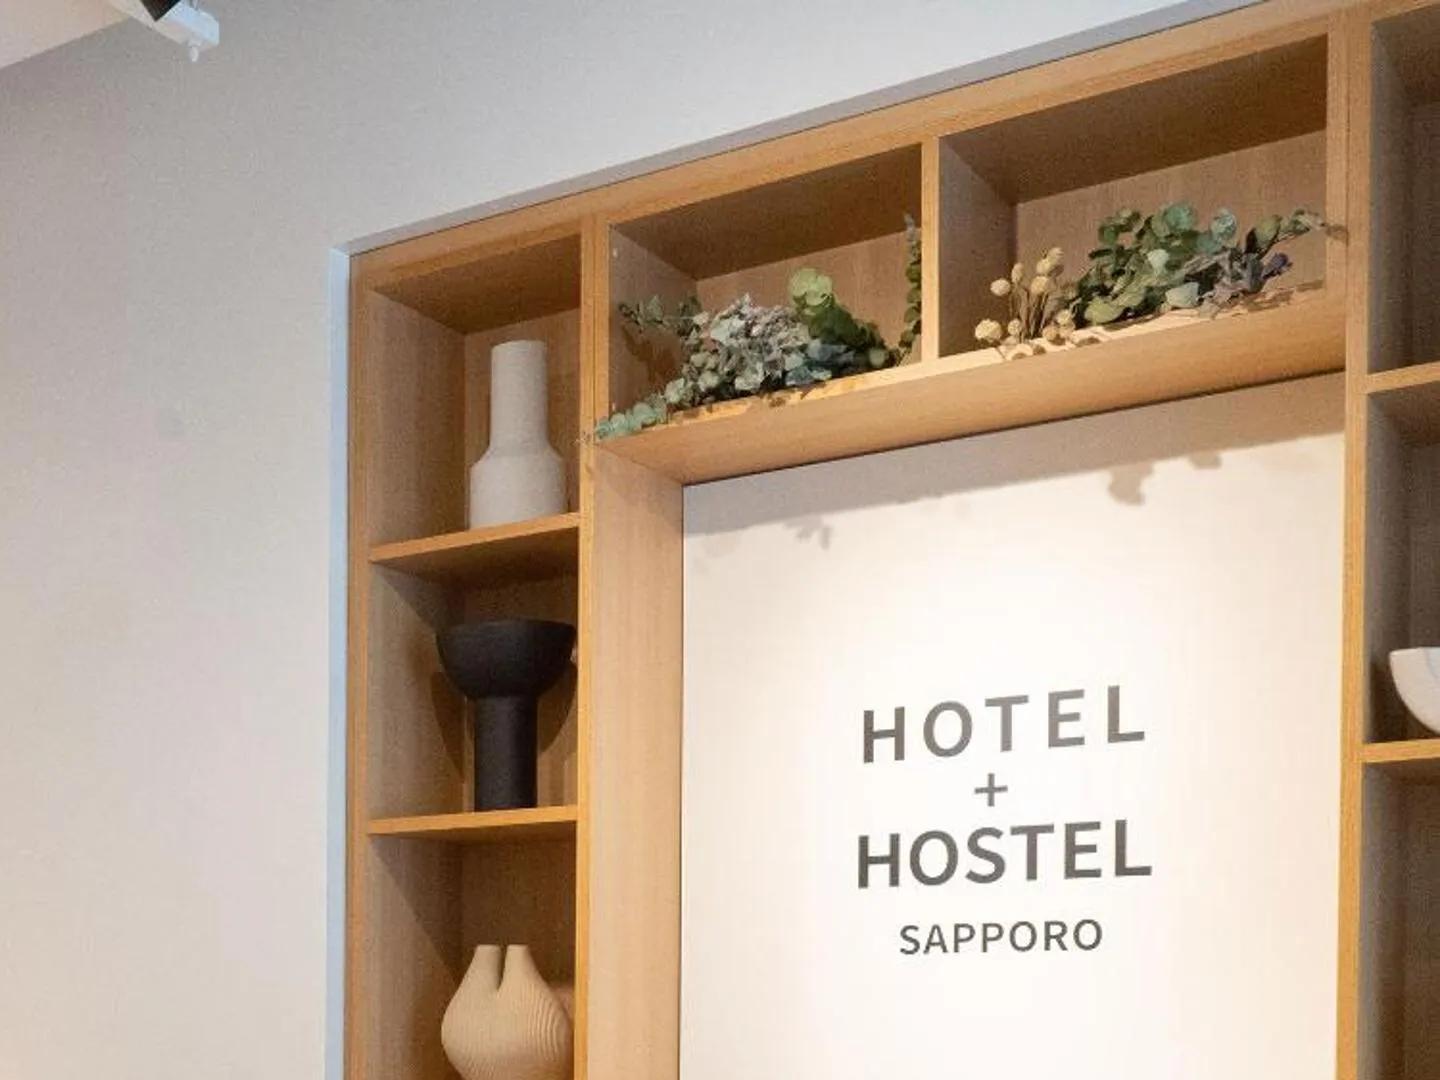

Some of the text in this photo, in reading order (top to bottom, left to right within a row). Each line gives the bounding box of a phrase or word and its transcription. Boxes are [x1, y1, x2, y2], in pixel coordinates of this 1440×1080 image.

[862, 685, 1146, 763] HOTEL
[857, 819, 1152, 889] HOSTEL
[899, 918, 1103, 955] SAPPORO
